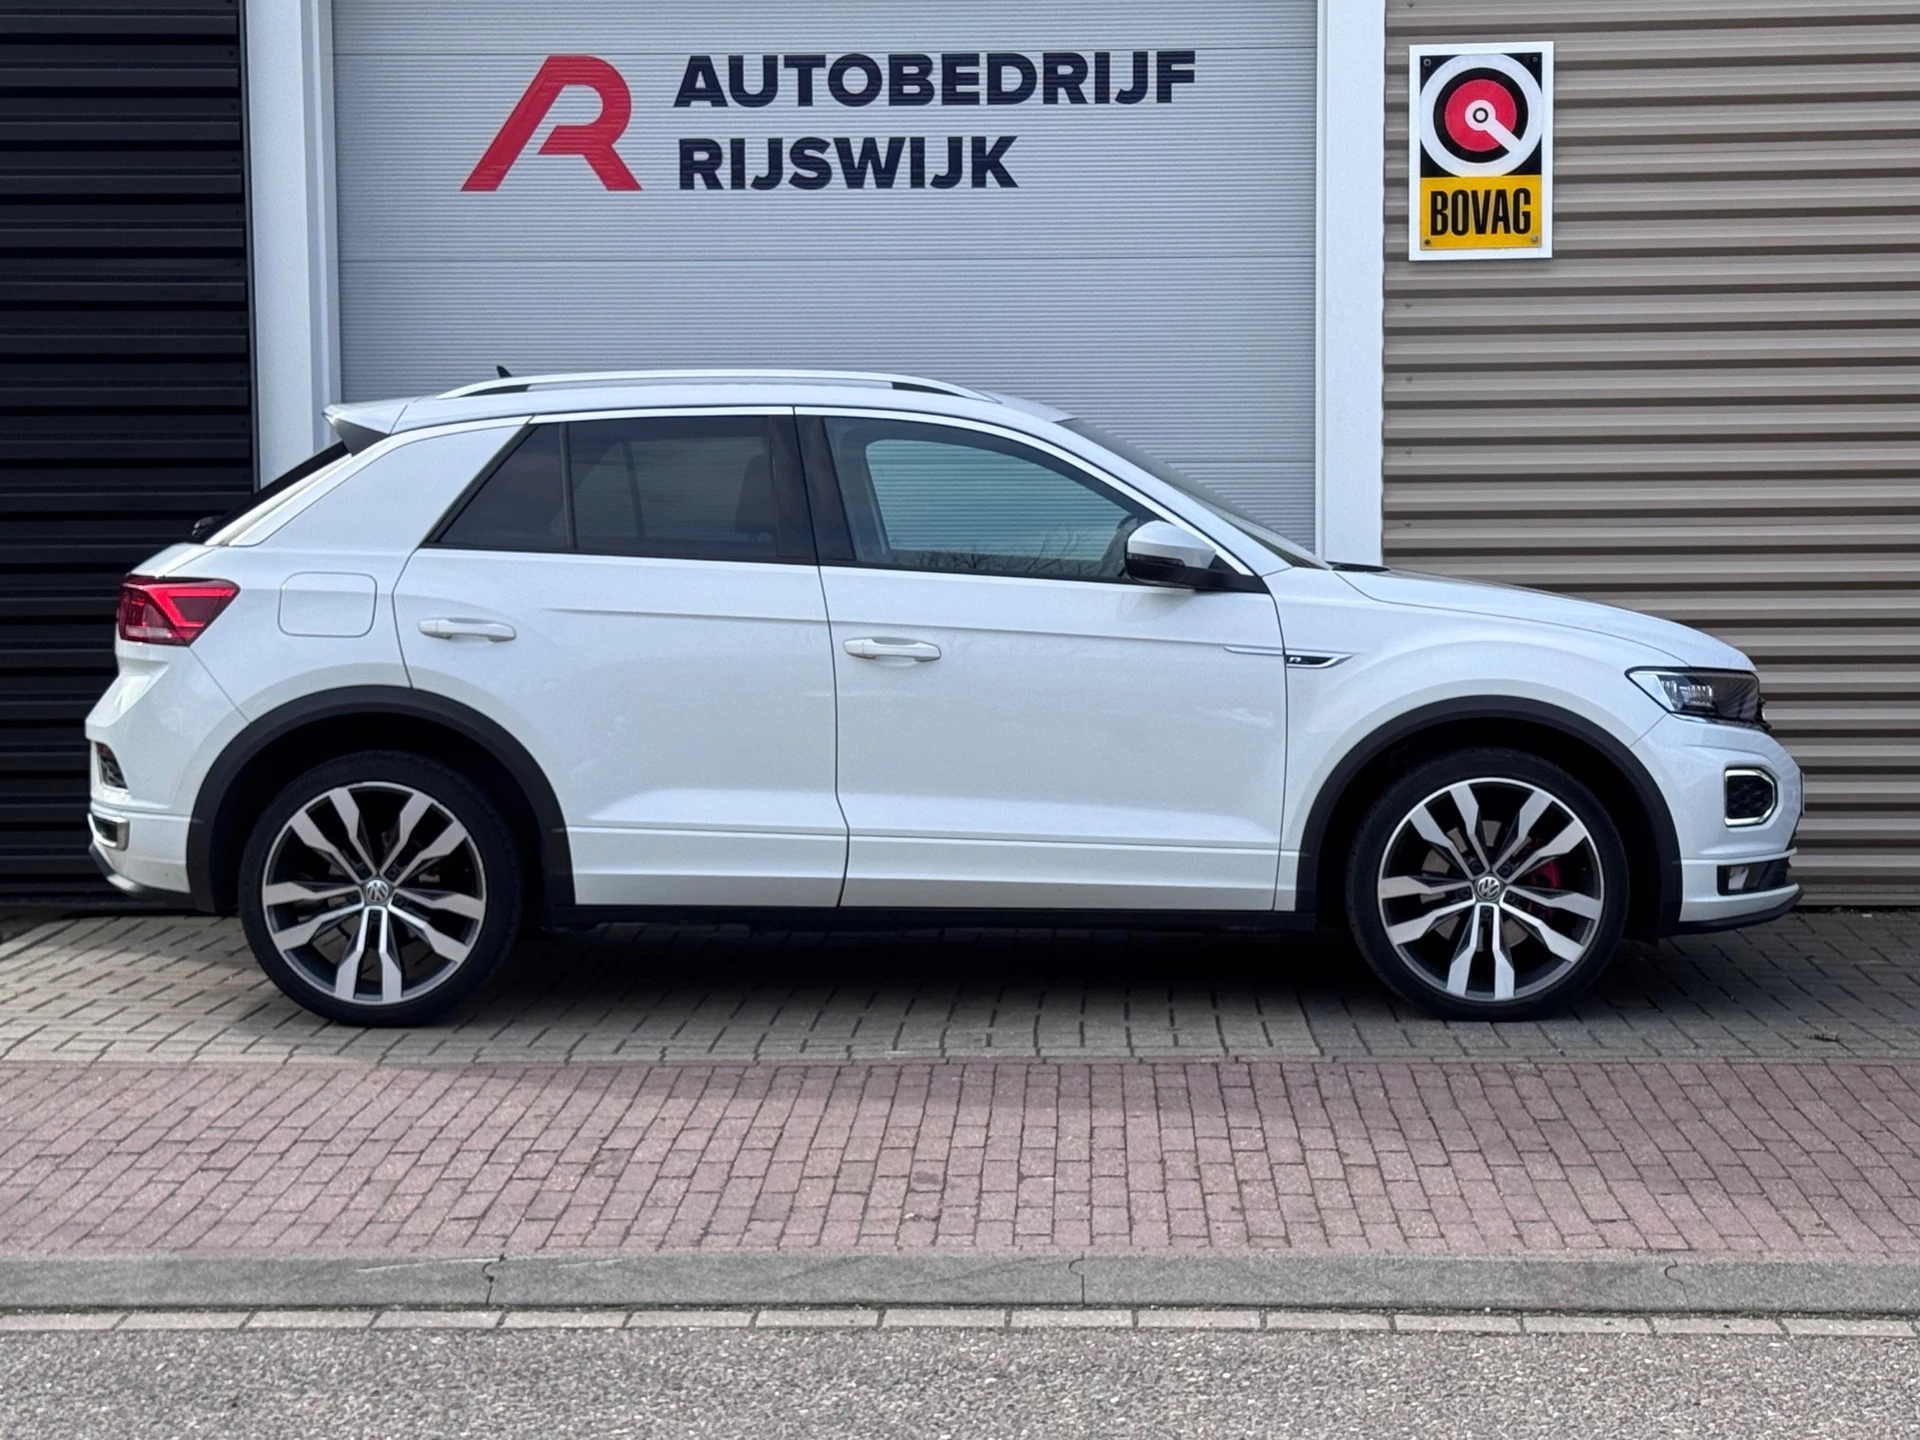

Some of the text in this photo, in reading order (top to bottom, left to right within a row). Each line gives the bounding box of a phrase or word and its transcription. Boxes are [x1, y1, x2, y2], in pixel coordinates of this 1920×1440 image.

[673, 51, 1196, 108] AUTOBEDRIJF
[679, 136, 1019, 191] RIJSWIJK
[1430, 188, 1532, 236] BOVAG
